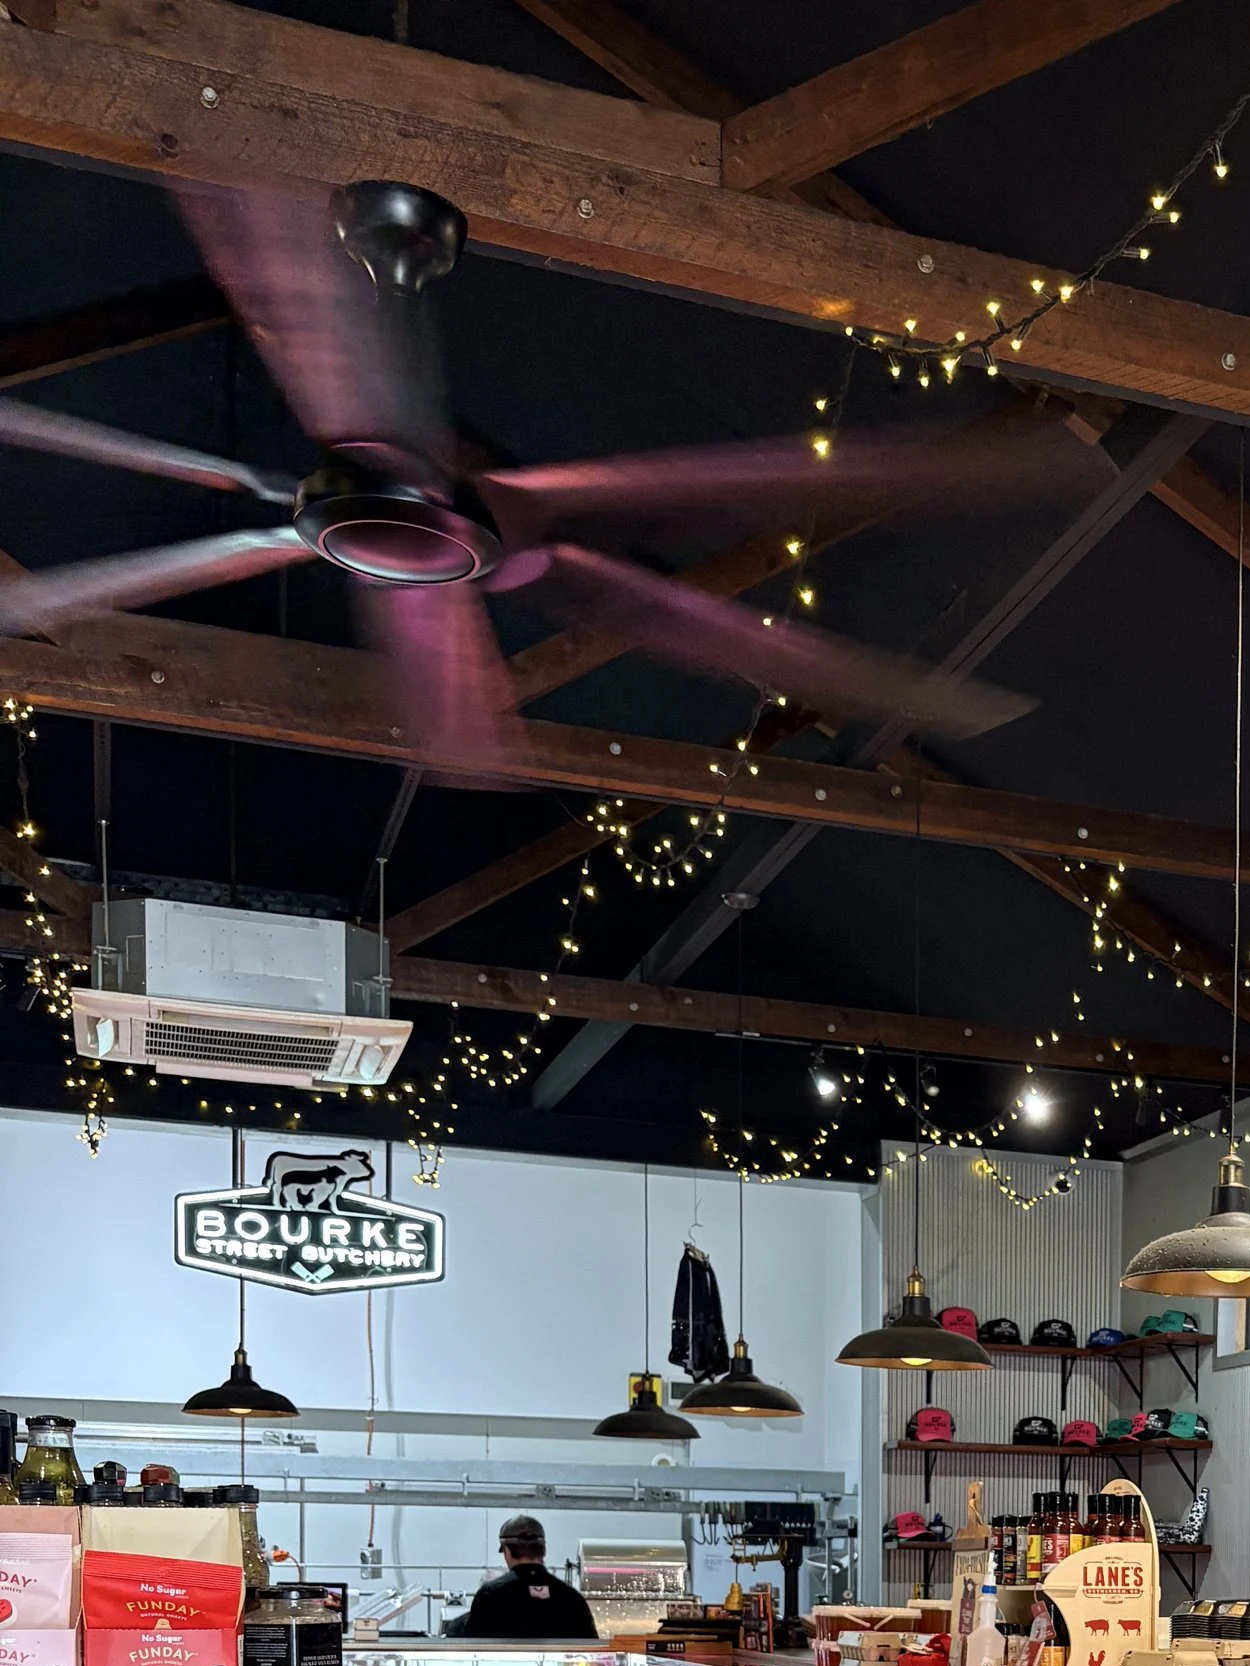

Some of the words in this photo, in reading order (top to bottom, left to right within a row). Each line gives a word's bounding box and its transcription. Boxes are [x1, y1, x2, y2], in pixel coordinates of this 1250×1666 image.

[196, 1210, 425, 1250] BOURKE
[195, 1238, 288, 1260] STREET
[301, 1245, 425, 1268] BUTCHERY
[1083, 1566, 1143, 1587] LANE'S
[140, 1583, 154, 1592] No
[157, 1585, 187, 1597] Sugar
[126, 1600, 201, 1616] FUNDAY
[142, 1634, 154, 1642] No
[156, 1635, 183, 1645] Sugar
[129, 1647, 194, 1663] FUNDAY
